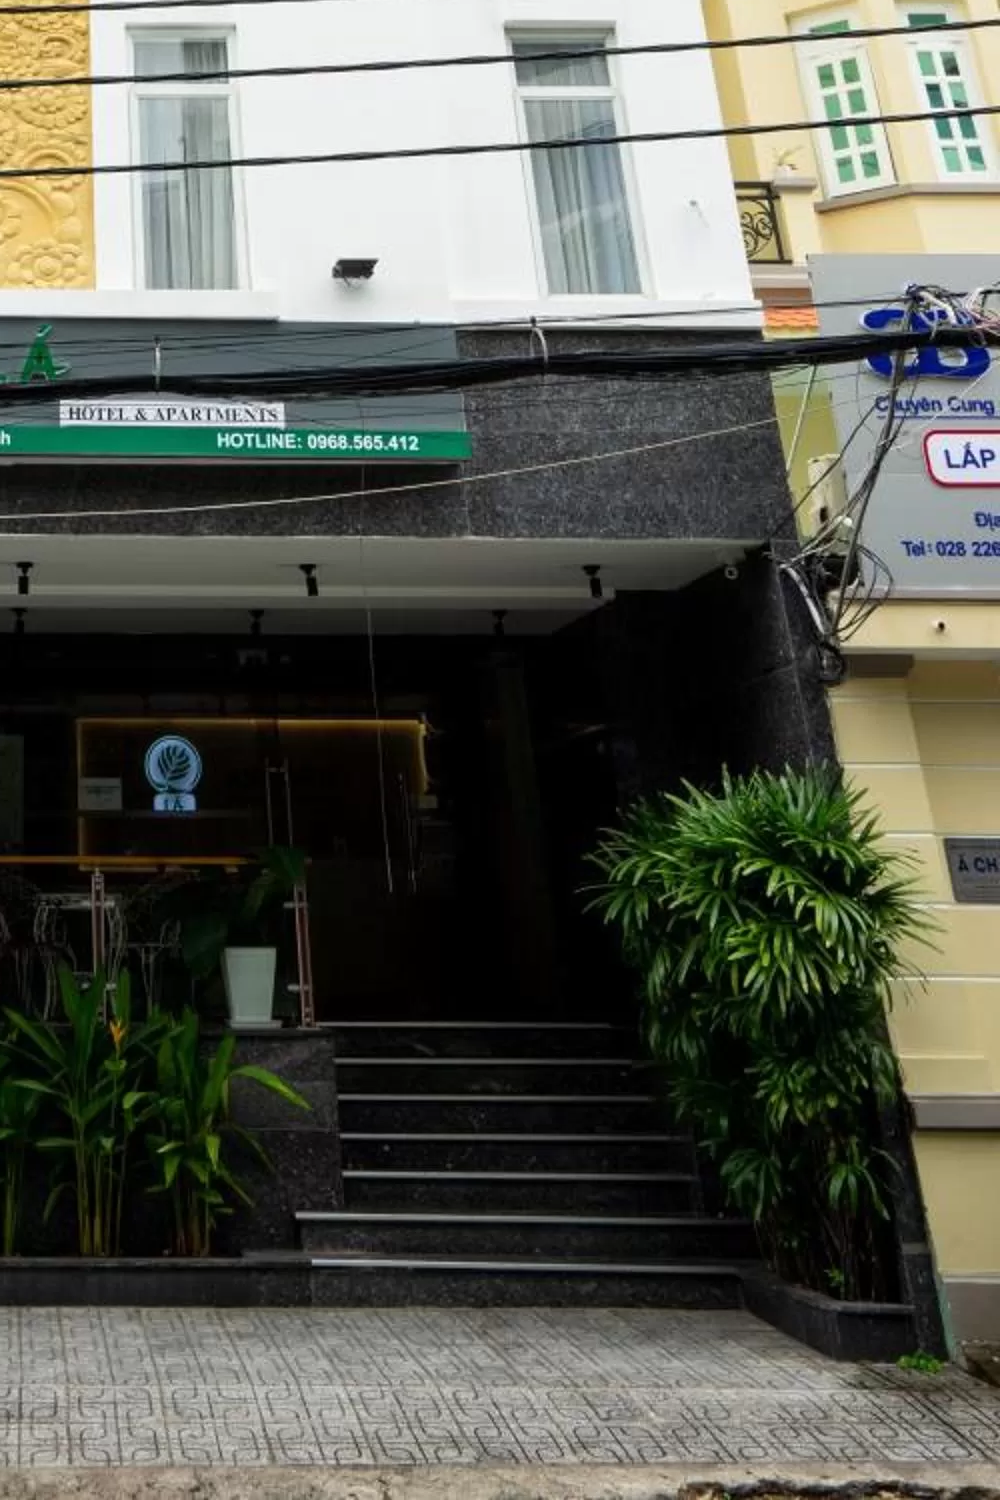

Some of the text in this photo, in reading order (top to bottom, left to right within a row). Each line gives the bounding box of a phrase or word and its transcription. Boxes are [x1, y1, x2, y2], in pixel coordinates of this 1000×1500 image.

[68, 406, 279, 424] HOTEL & APARTMENTS
[875, 395, 996, 416] Cuyên Cung
[216, 432, 420, 452] HOTLINE: 0968.565.412
[901, 540, 933, 557] Tel:
[935, 540, 967, 557] 028
